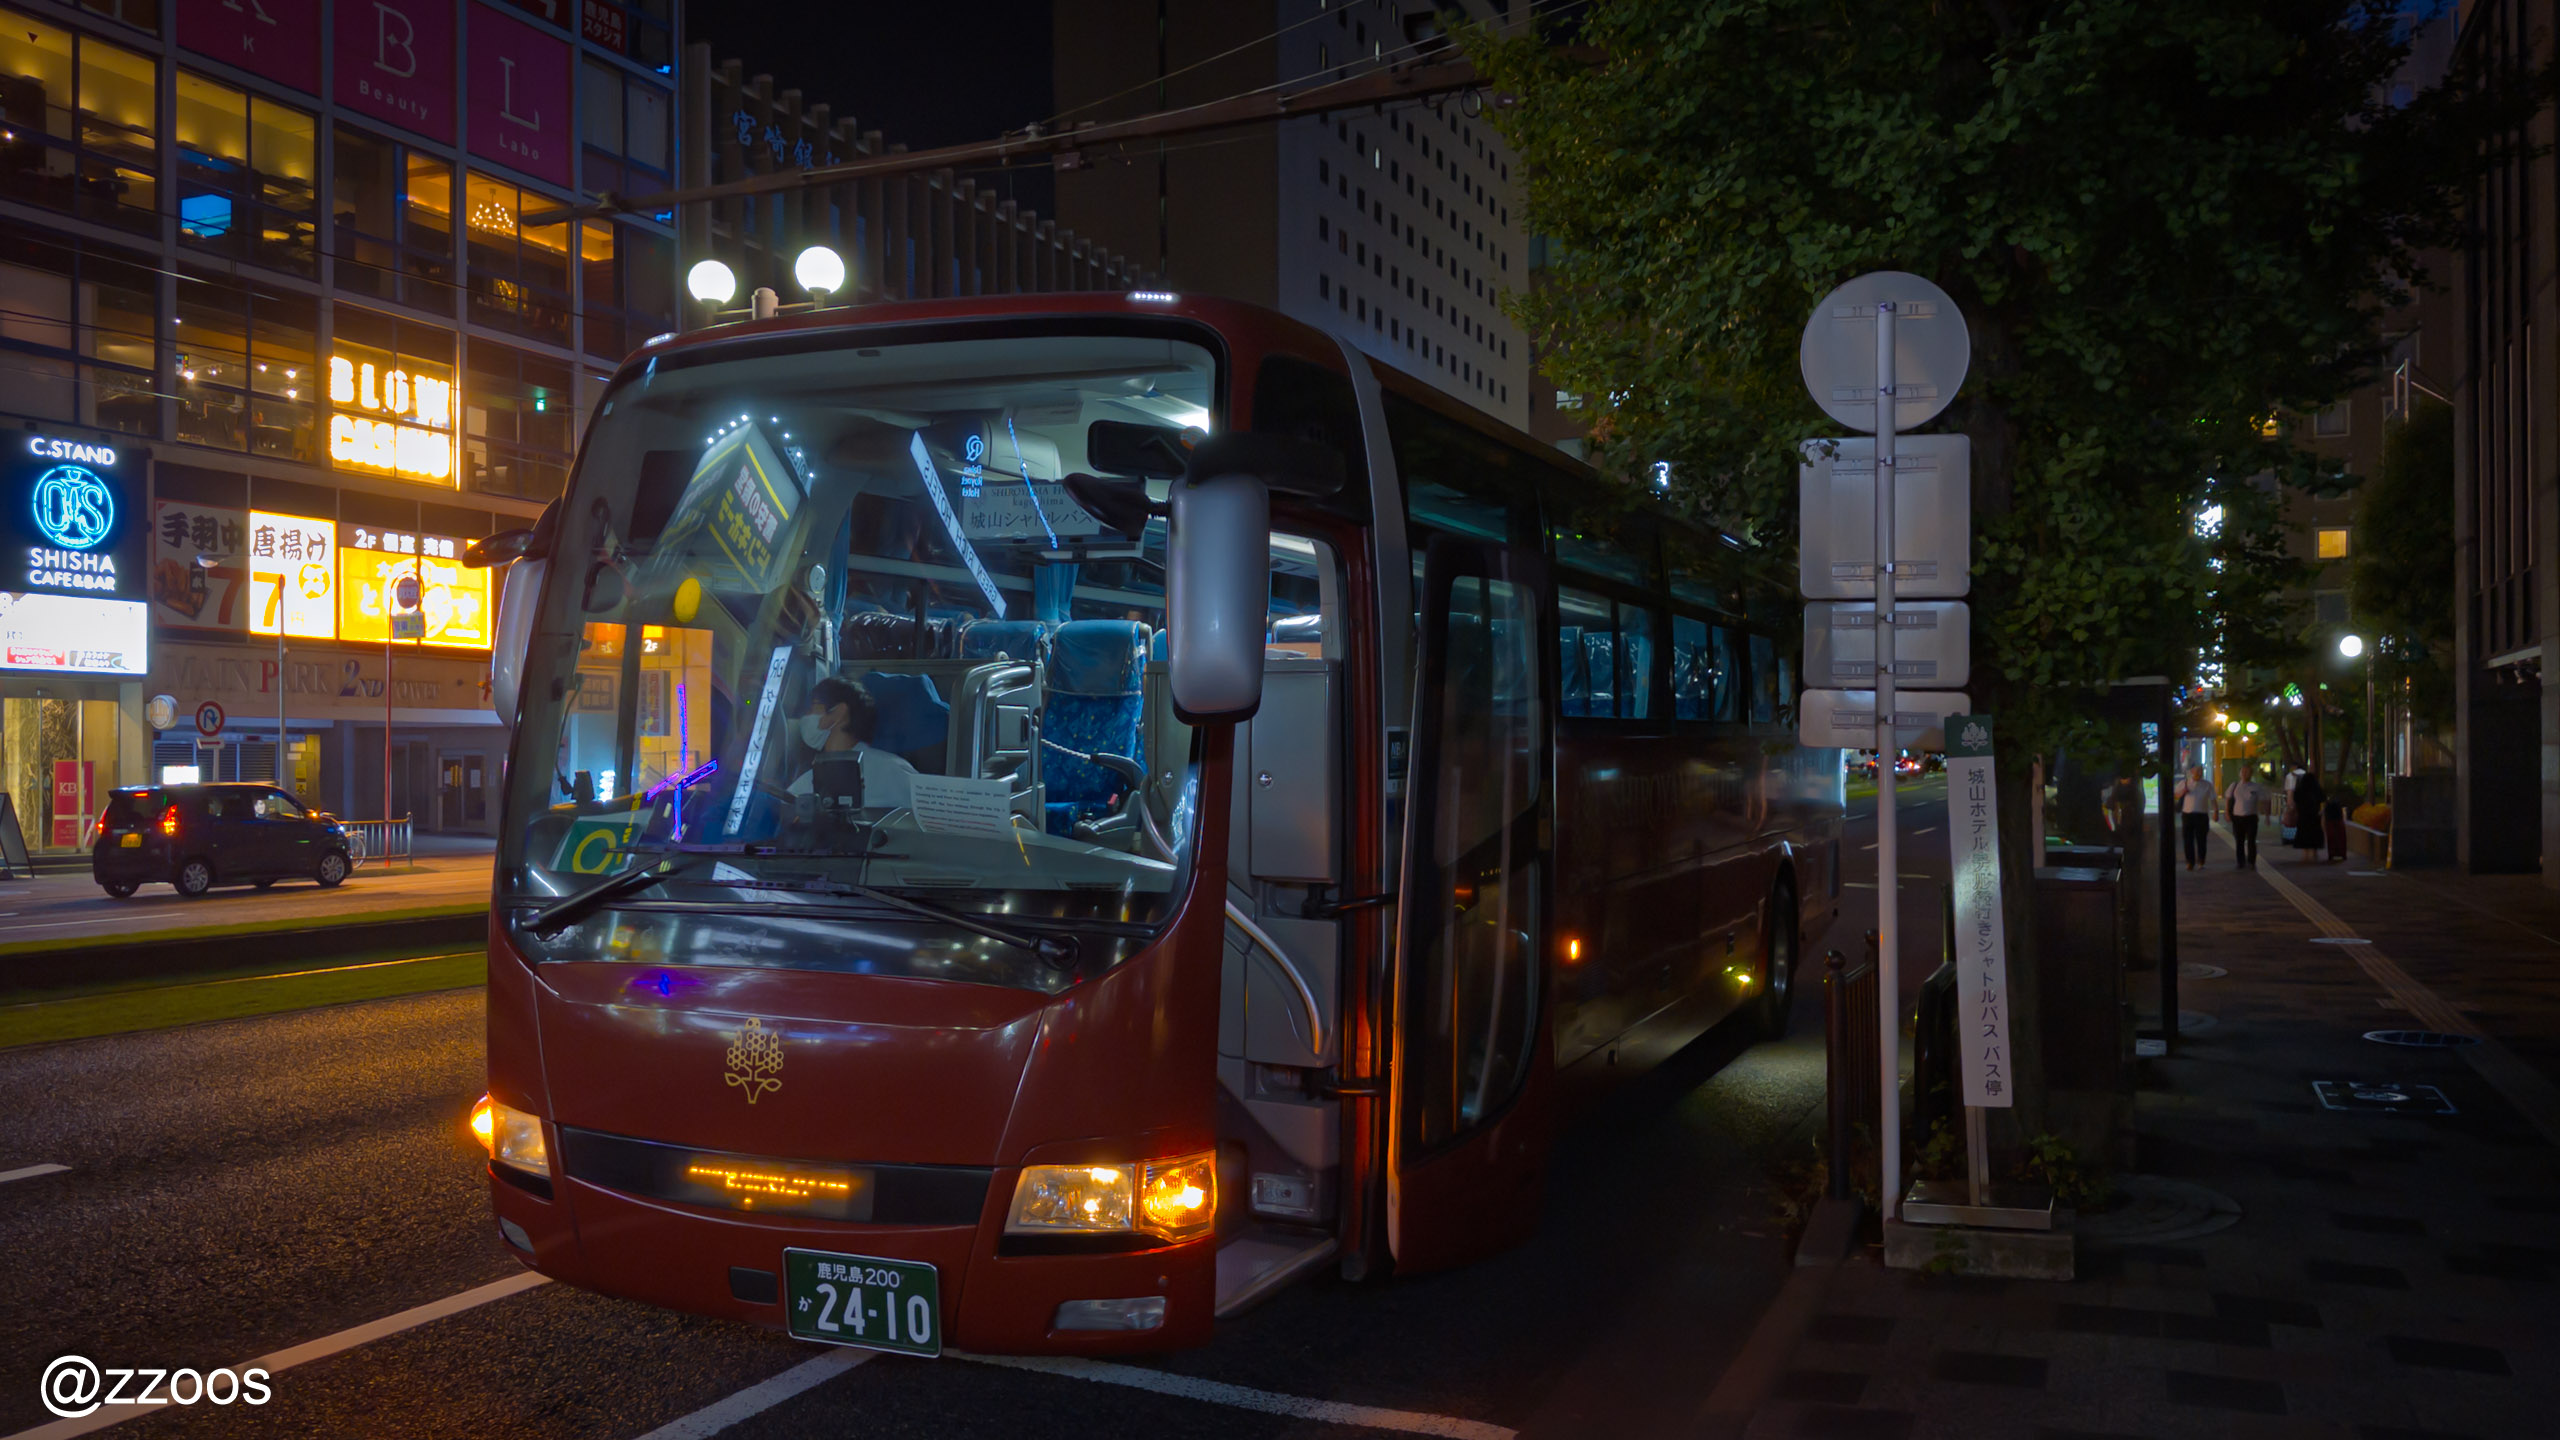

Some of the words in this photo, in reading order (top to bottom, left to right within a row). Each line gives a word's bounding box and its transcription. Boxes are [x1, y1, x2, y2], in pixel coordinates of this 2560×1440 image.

[584, 1, 621, 31] 鹿児島
[243, 34, 255, 53] K
[373, 2, 416, 77] B
[584, 18, 621, 49] スタジオ
[360, 79, 428, 120] Beauty
[500, 56, 539, 131] L
[500, 132, 540, 160] Labo
[330, 356, 450, 424] BLOW
[30, 437, 116, 466] C.STAND
[1013, 497, 1064, 507] kagohima
[161, 511, 244, 553] 手羽中
[971, 509, 1093, 529] 城山シャトルバス
[354, 528, 377, 550] 2F
[30, 547, 116, 574] SHISHA
[29, 569, 116, 591] CAFE&BAR
[165, 656, 251, 694] MAIN
[339, 658, 385, 698] 2ND
[1968, 766, 1999, 1038] 城山ホテル行きシャトルバス
[1983, 1045, 2003, 1097] バス停
[816, 1282, 931, 1345] 24-10
